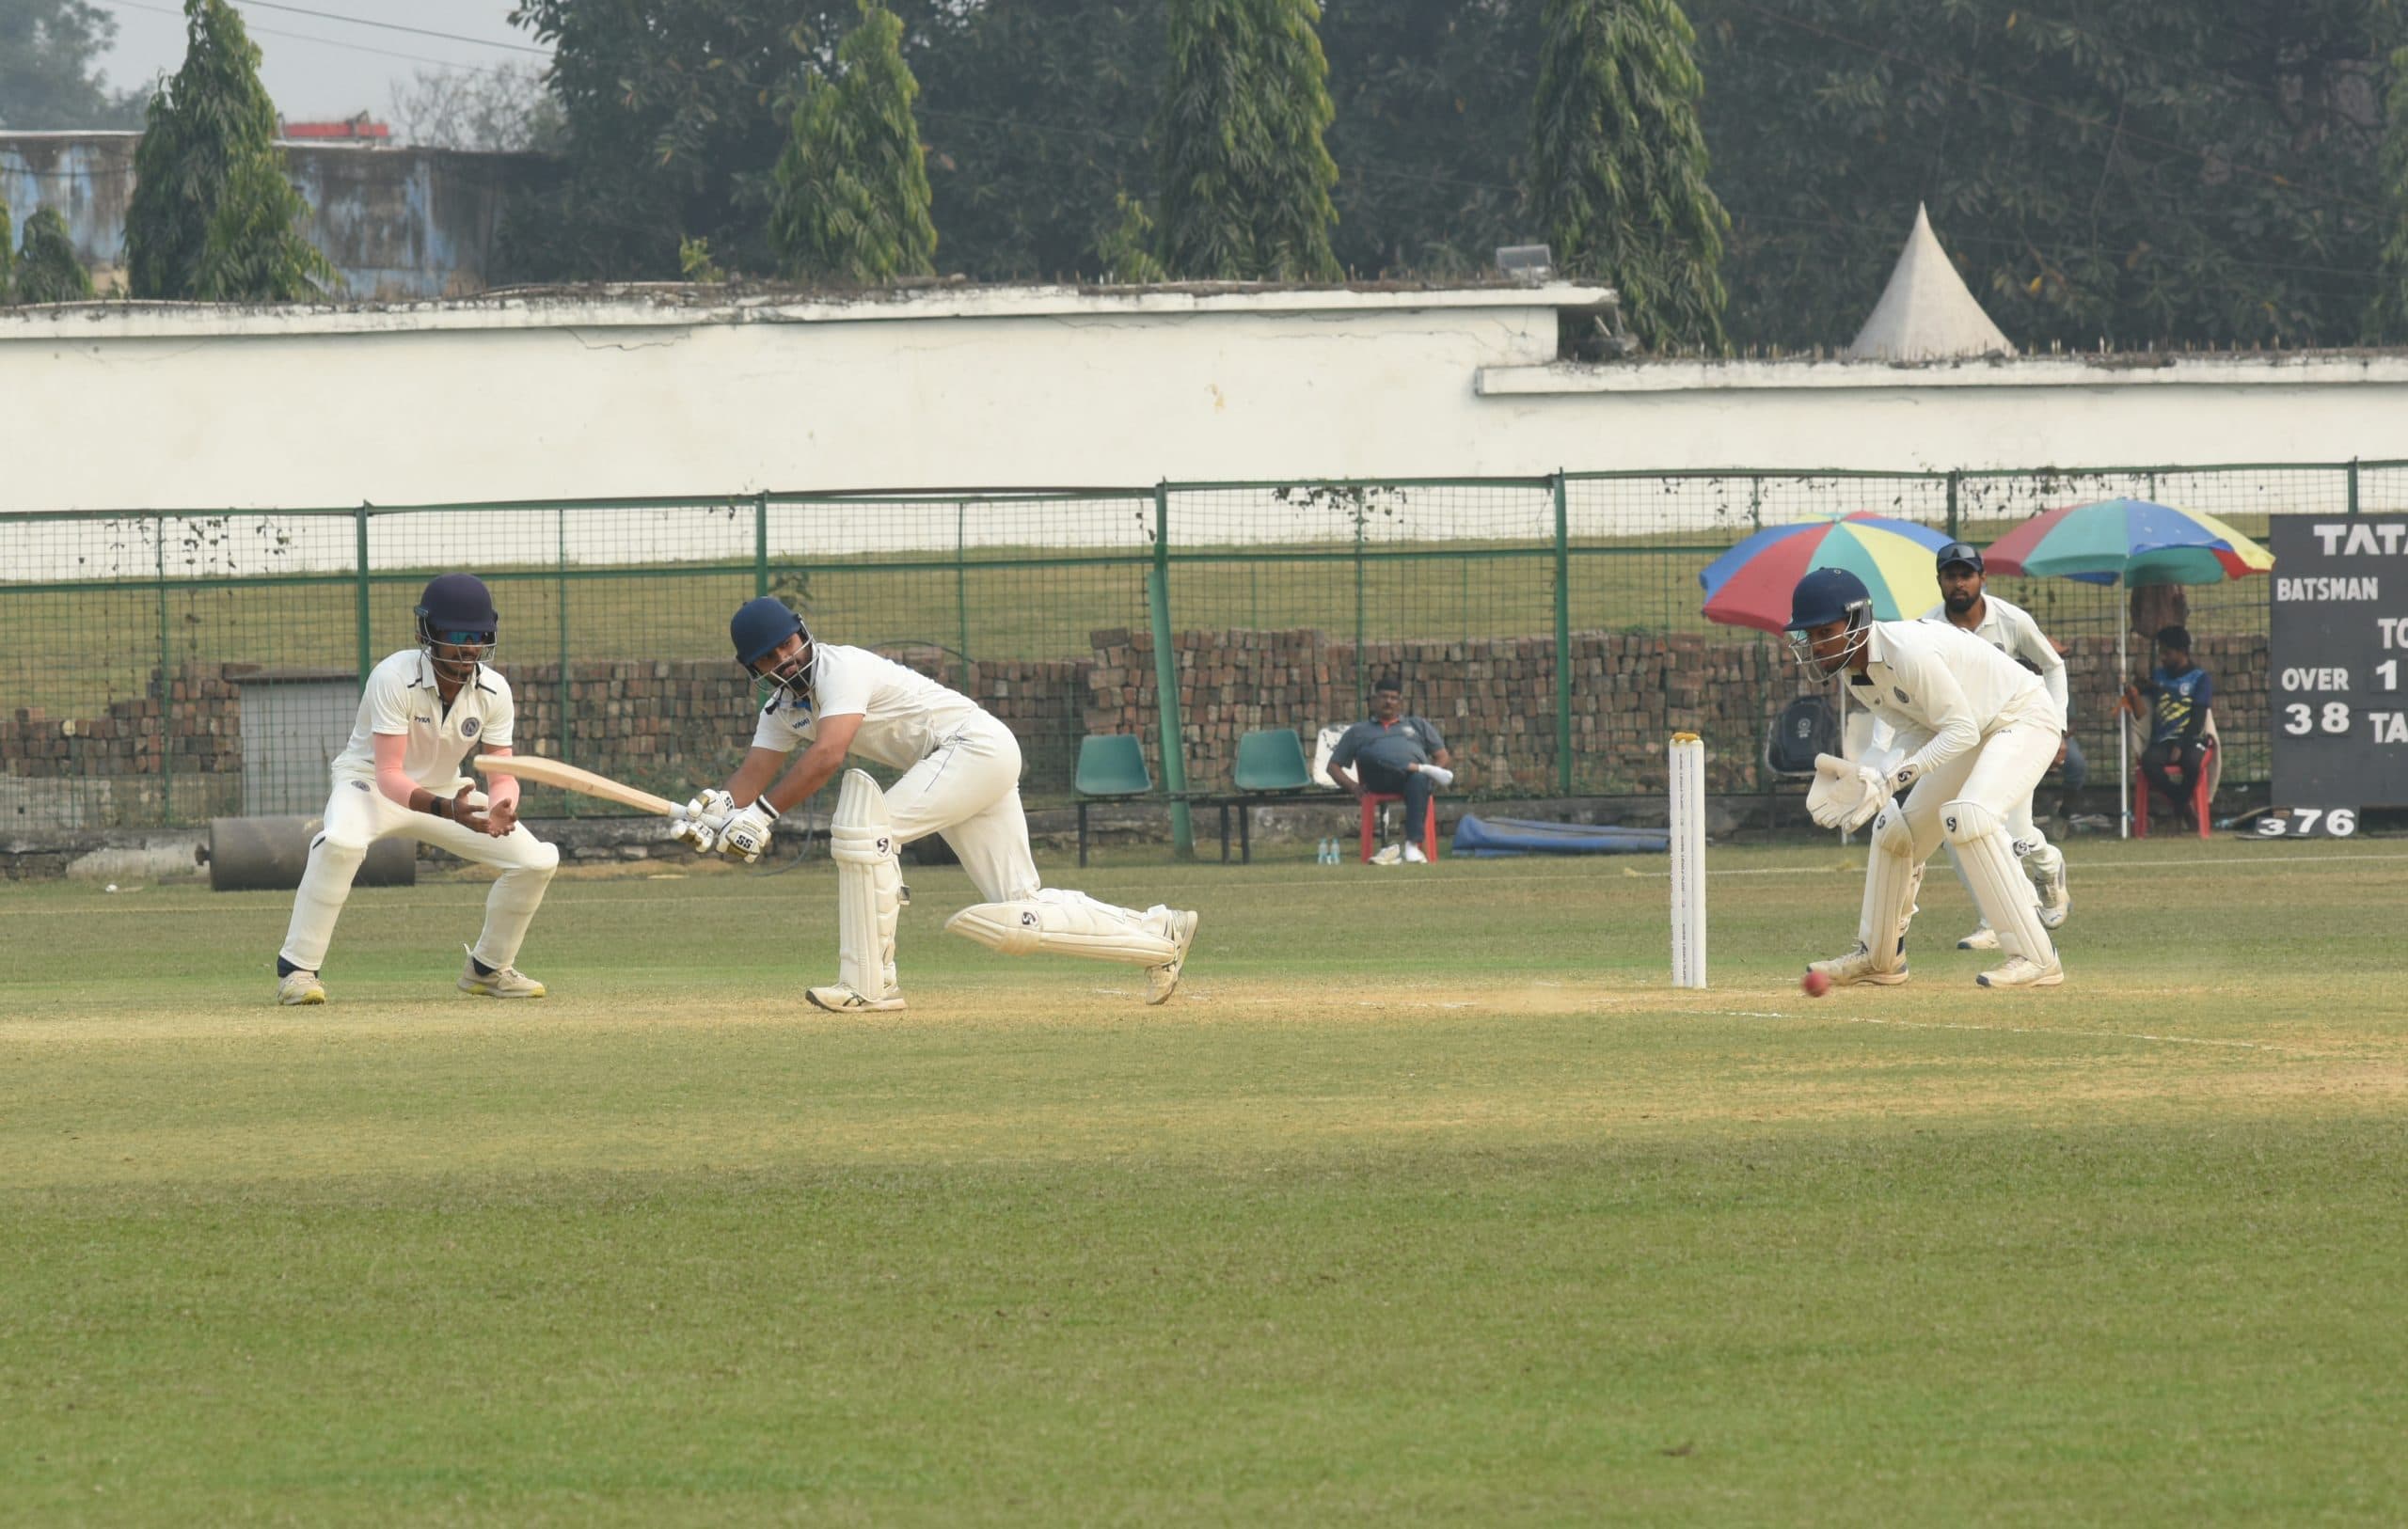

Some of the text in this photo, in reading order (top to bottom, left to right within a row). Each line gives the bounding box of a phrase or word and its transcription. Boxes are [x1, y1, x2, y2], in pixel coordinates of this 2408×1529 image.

[2314, 524, 2408, 556] TAT
[2276, 576, 2379, 602] BATSMAN
[2281, 668, 2350, 691] OVER
